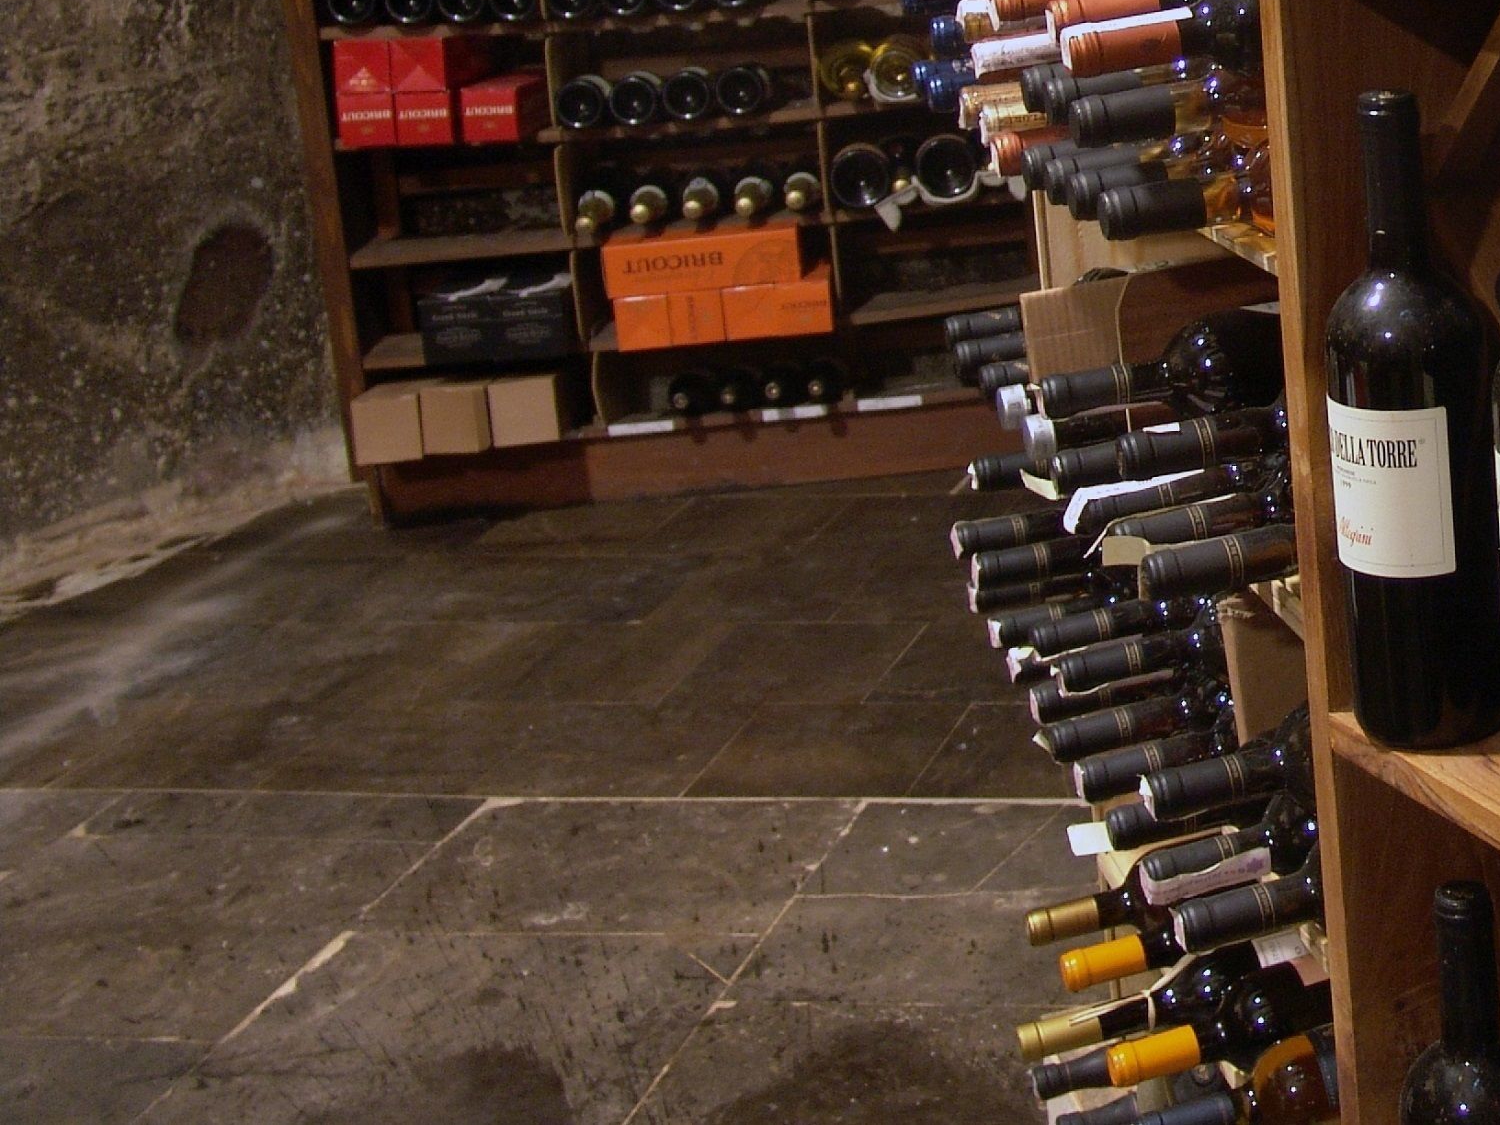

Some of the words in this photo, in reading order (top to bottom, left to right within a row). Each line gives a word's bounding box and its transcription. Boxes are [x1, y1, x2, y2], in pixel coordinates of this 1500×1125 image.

[341, 109, 391, 123] BRICOUT
[399, 107, 448, 122] BRICOUT
[465, 105, 514, 118] BRICOUT
[622, 250, 726, 274] BRICOUT
[1367, 439, 1418, 469] TORRE
